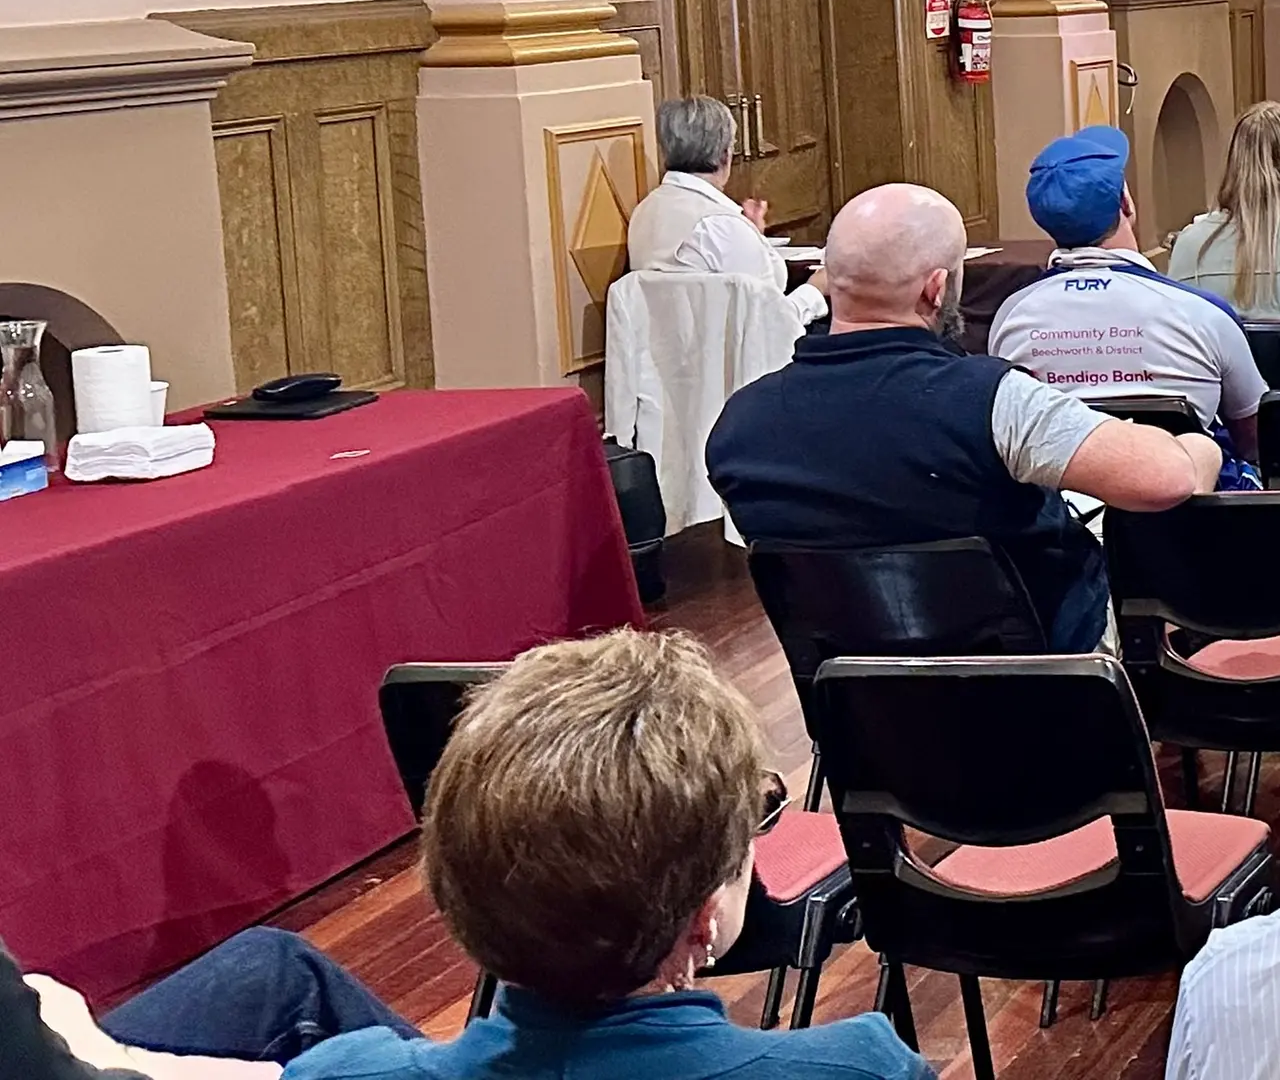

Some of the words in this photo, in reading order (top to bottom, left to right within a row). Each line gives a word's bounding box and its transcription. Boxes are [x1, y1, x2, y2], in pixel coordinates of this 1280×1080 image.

[1064, 279, 1112, 291] FURY
[1030, 328, 1105, 341] Community
[1109, 327, 1144, 338] Bank
[1031, 347, 1093, 357] Beechworth
[1095, 346, 1103, 355] &
[1105, 346, 1142, 355] District
[1046, 371, 1108, 386] Bendigo
[1112, 370, 1154, 382] Bank
